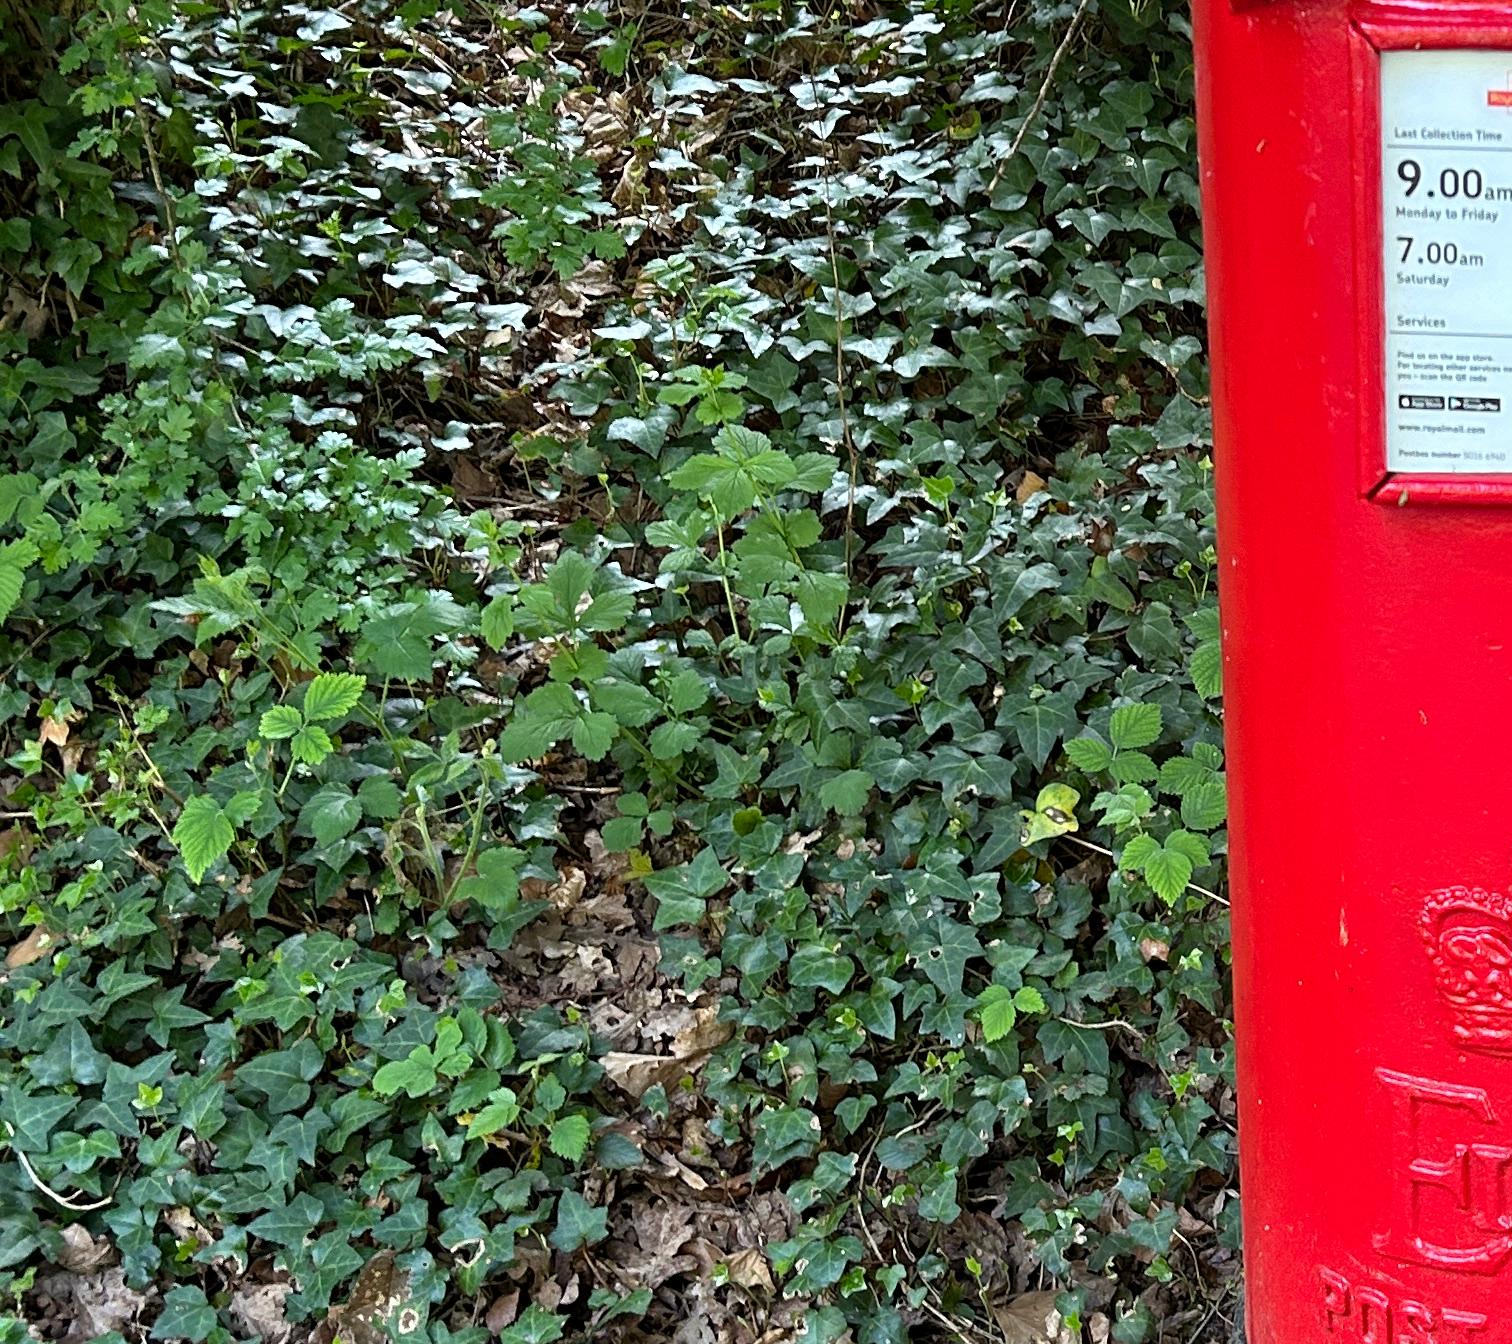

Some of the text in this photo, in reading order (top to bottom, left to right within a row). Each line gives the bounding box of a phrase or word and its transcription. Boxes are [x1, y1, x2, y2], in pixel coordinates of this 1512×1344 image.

[1394, 126, 1503, 142] Last Collection Time
[1395, 206, 1498, 223] Monday to Friday
[1396, 236, 1484, 266] 7.00am
[1396, 272, 1449, 287] Saturday
[1397, 314, 1446, 328] Services
[1398, 424, 1485, 434] www.royalmail.com
[1399, 447, 1428, 457] Postbox
[1431, 450, 1461, 458] number
